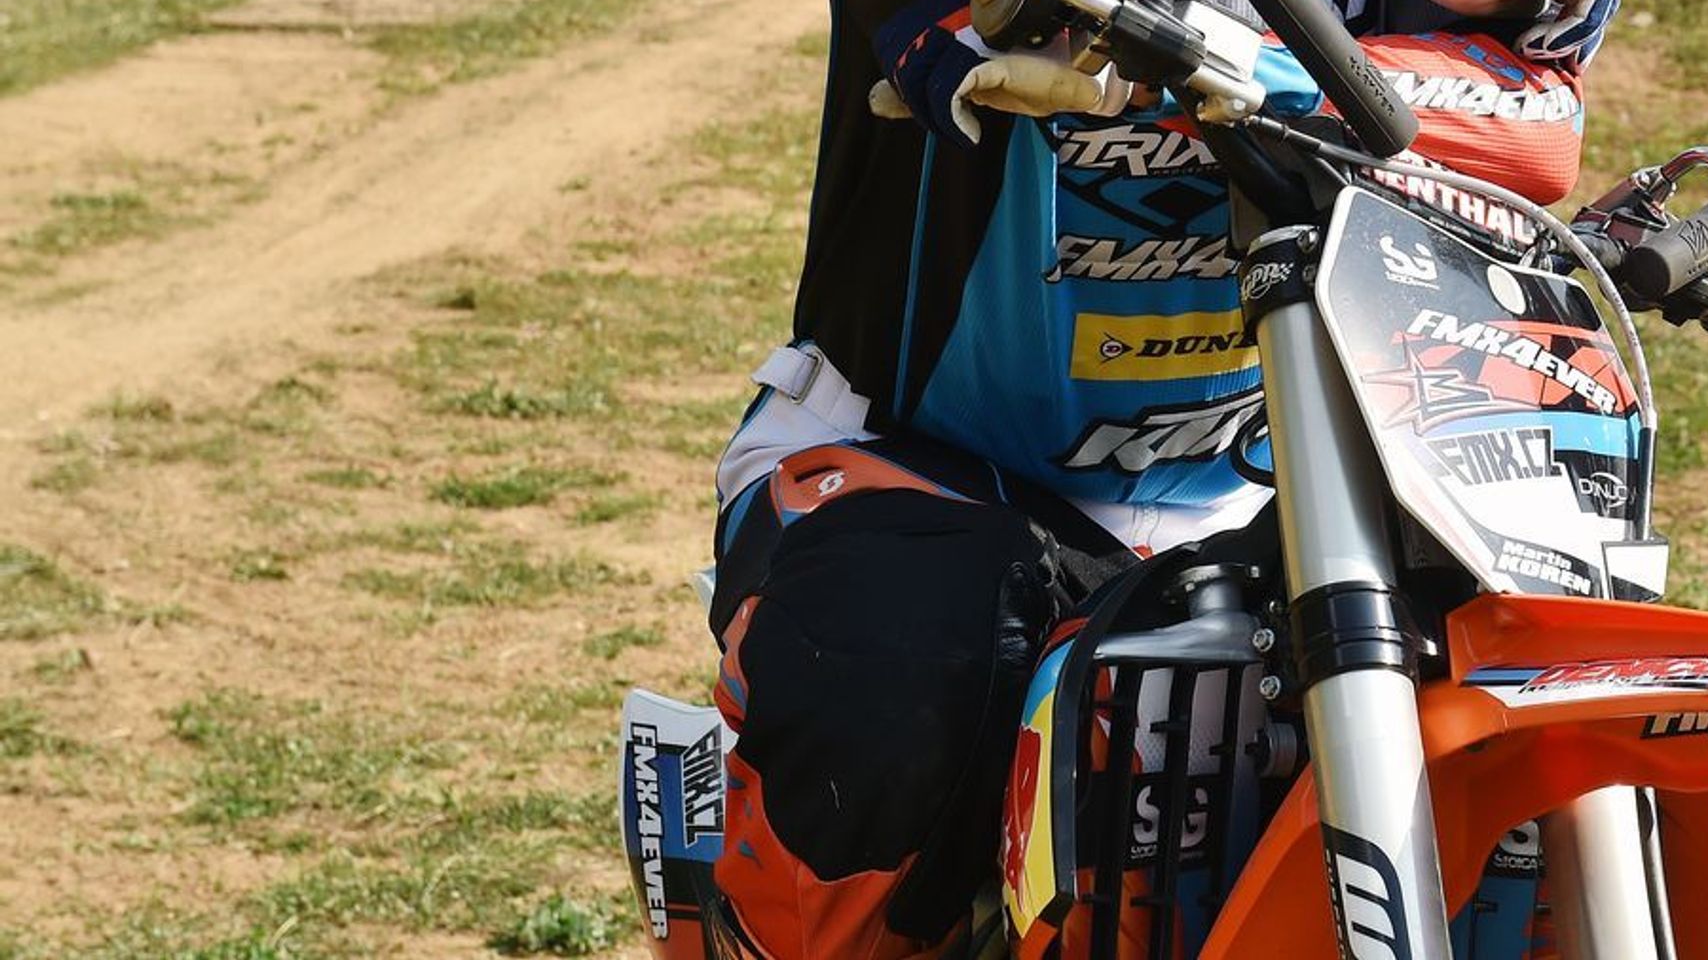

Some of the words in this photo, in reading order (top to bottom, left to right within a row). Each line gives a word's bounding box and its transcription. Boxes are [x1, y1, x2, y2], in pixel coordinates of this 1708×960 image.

[1407, 308, 1617, 417] FMX4EVER
[1498, 553, 1591, 595] KOREN
[631, 725, 669, 939] FMX4EVER
